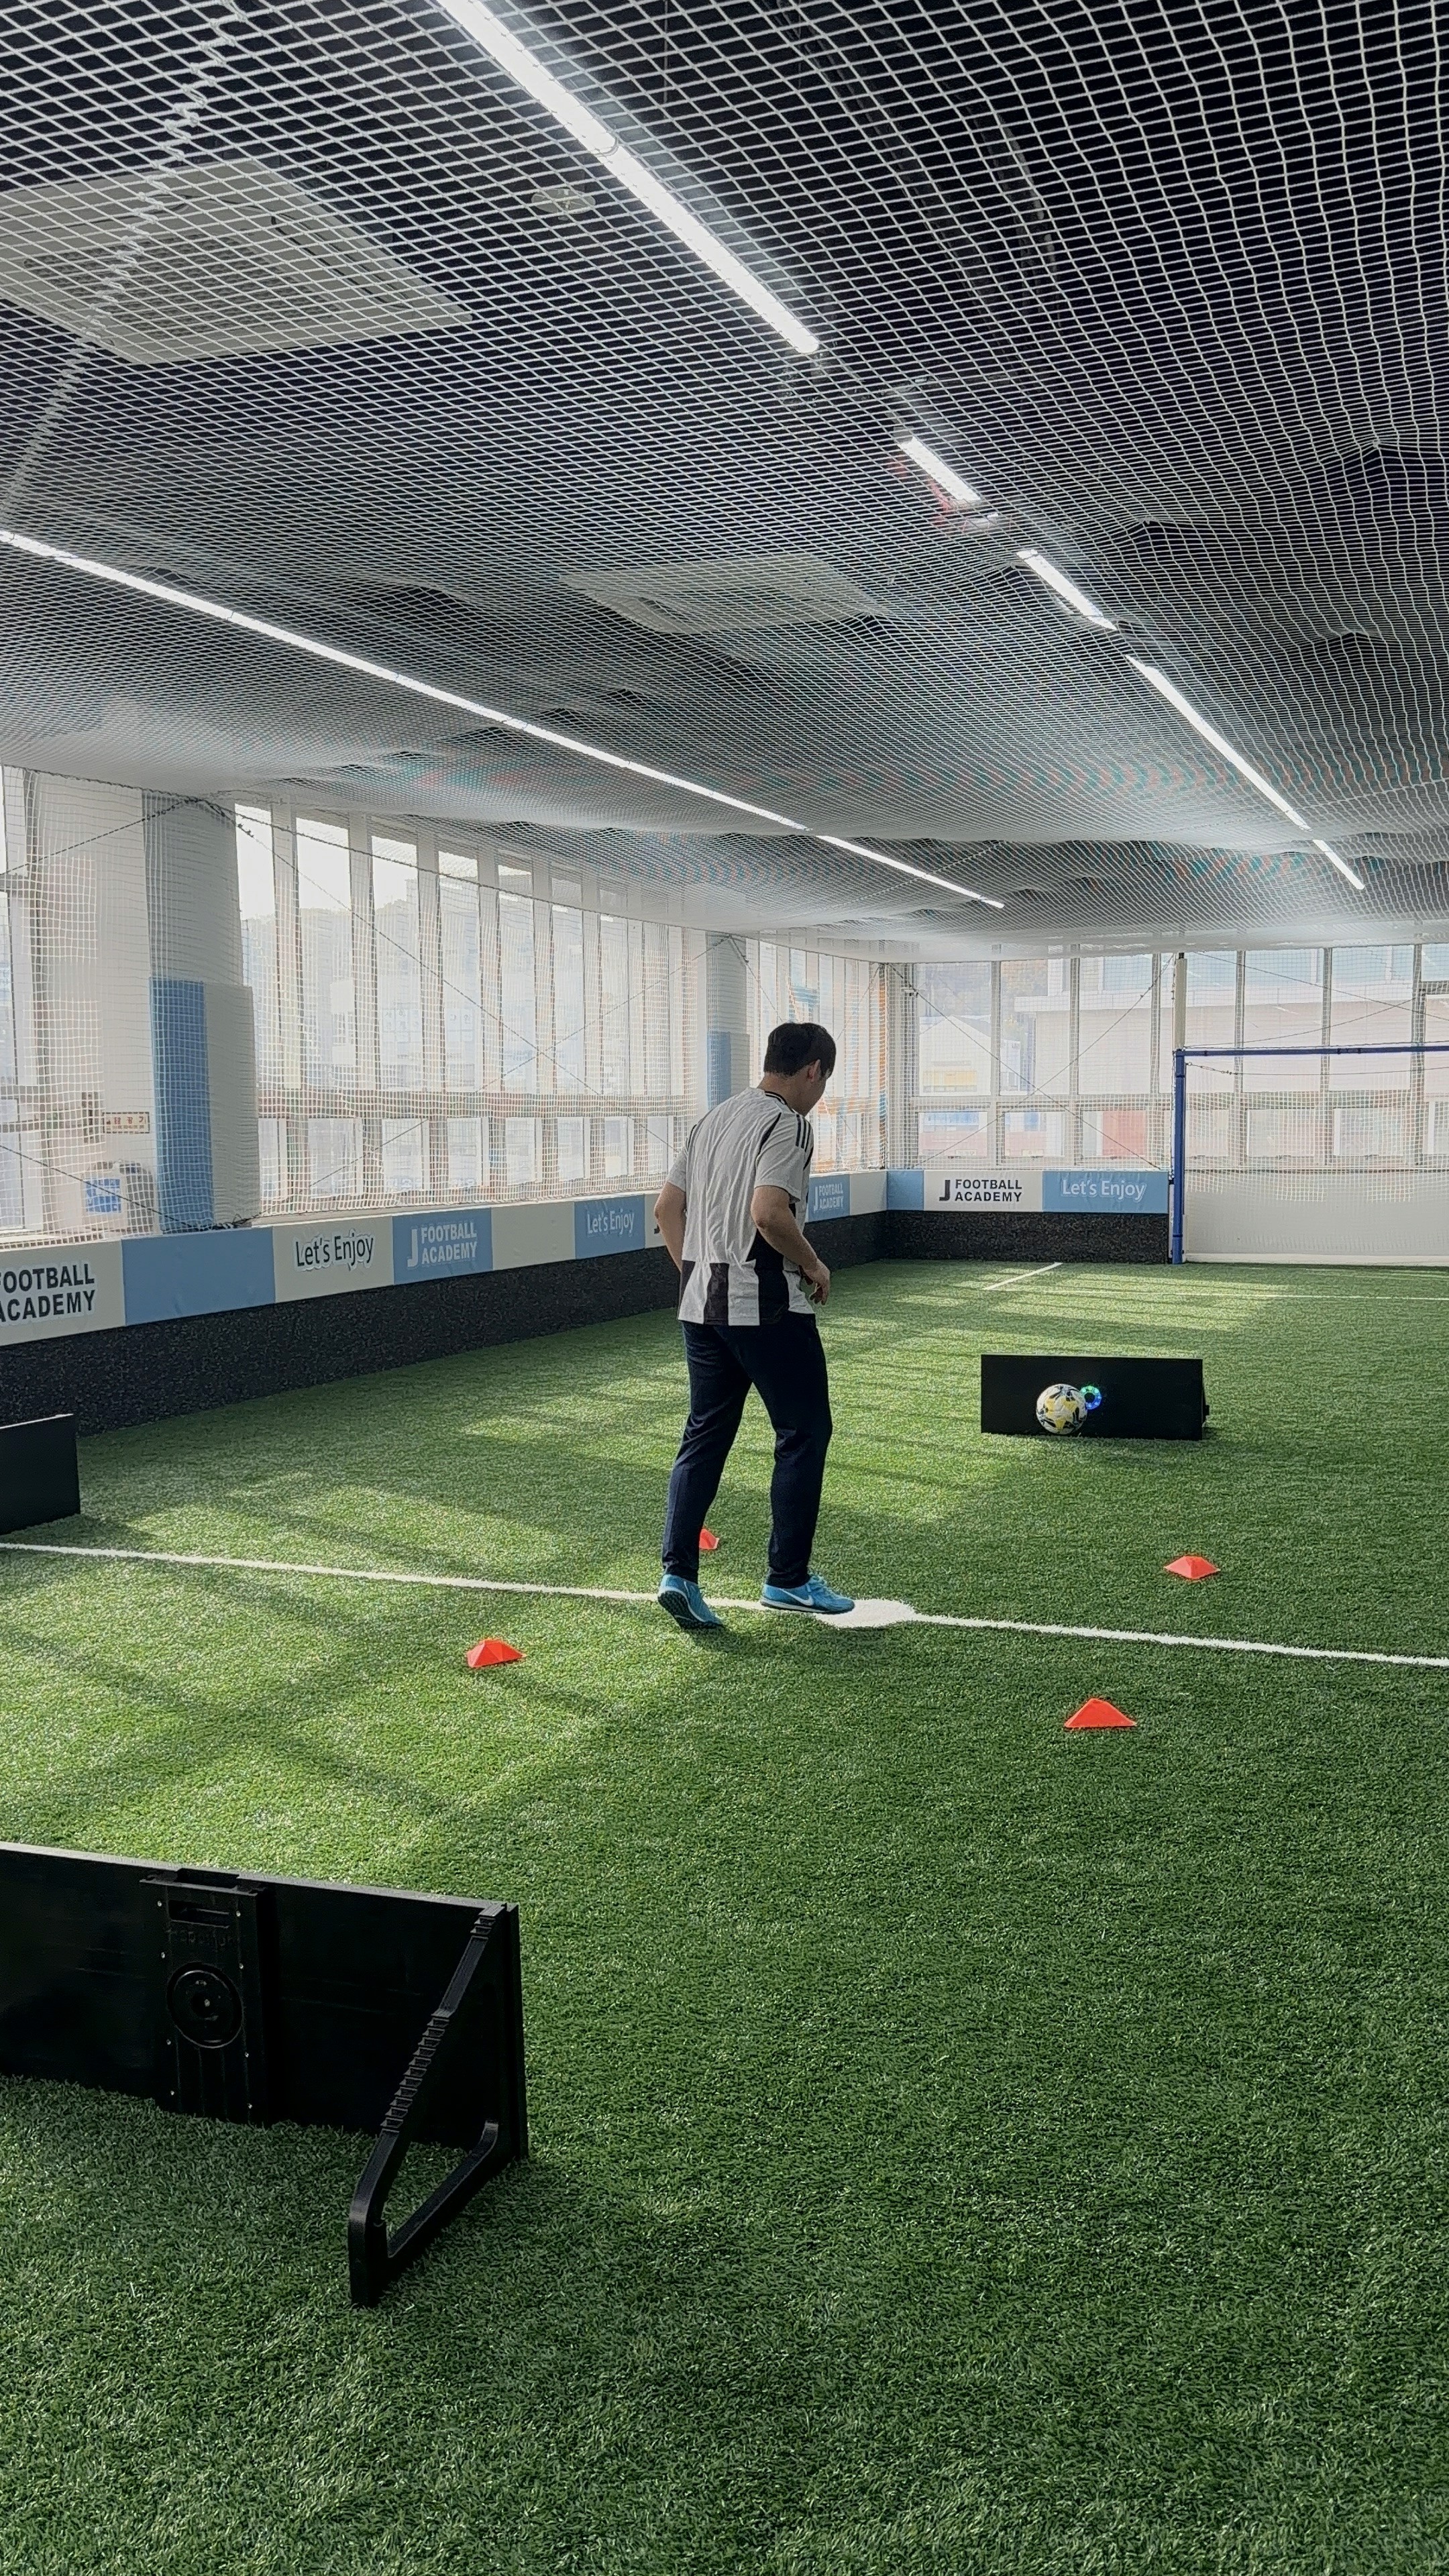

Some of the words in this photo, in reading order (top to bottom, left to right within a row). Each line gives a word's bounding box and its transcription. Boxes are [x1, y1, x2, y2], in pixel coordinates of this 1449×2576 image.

[818, 1182, 844, 1196] FOOTBALL
[939, 1179, 951, 1201] J
[955, 1179, 1022, 1189] FOOTBALL
[1063, 1180, 1097, 1195] Let's
[1101, 1180, 1145, 1201] Enjoy
[819, 1196, 844, 1210] ACADEMY
[954, 1191, 1022, 1201] ACADEMY
[587, 1212, 608, 1234] Let's
[610, 1208, 635, 1234] Enjoy
[421, 1222, 477, 1244] FOOTBALL
[296, 1237, 330, 1267] Let's
[334, 1233, 374, 1266] Enjoy
[407, 1229, 419, 1267] J
[421, 1241, 477, 1265] ACADEMY
[0, 1263, 95, 1293] OOTBALL
